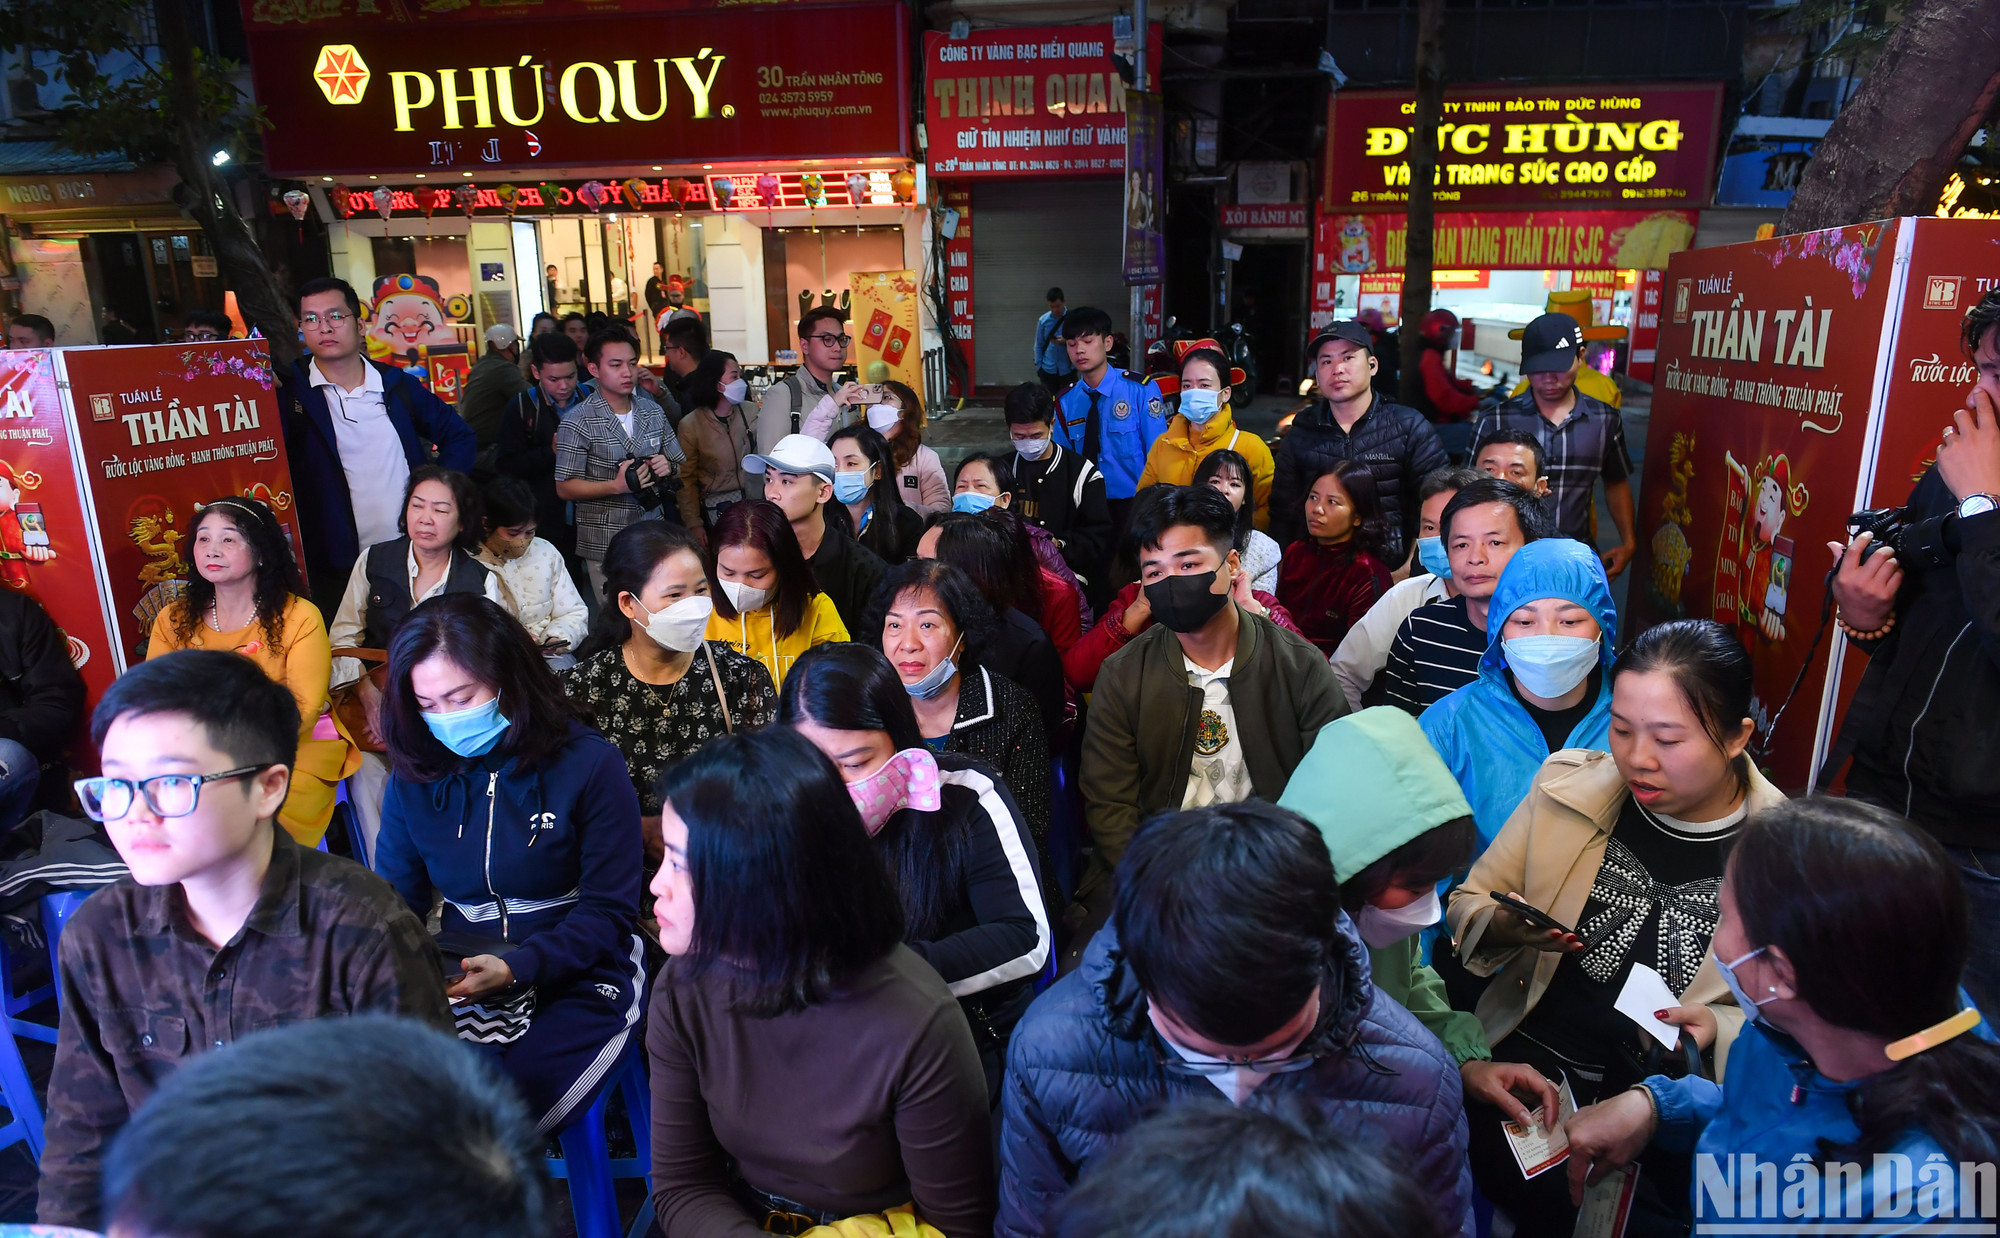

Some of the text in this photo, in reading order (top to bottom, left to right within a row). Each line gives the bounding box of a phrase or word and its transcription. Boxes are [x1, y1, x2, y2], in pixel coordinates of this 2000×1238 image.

[939, 44, 968, 62] CÔNG
[970, 46, 984, 61] TY
[986, 41, 1014, 60] VÀNG
[1017, 43, 1038, 63] BẠC
[1068, 42, 1104, 58] QUANG
[757, 66, 784, 88] 30
[819, 70, 851, 87] NHÂN
[852, 70, 883, 86] TÔNG
[388, 47, 726, 132] PHÚ QUÝ
[758, 91, 834, 104] 024 3573 5959
[933, 72, 1151, 124] THỊNH QUAN
[761, 104, 872, 119] www.phuquy.com.vn
[1443, 102, 1461, 113] TY
[1464, 101, 1501, 113] TNHH
[1504, 97, 1535, 112] BẢO
[1537, 97, 1560, 111] TÍN
[1565, 97, 1595, 111] ĐỨC
[1600, 96, 1641, 110] HÙNG
[957, 127, 978, 148] GIỮ
[981, 127, 1001, 147] TÍN
[1003, 128, 1041, 150] NHIỆM
[1044, 127, 1070, 145] NHƯ
[1072, 124, 1094, 145] GIỮ
[1097, 124, 1127, 145] VÀNG
[1503, 112, 1684, 154] HÙNG
[1447, 163, 1515, 186] TRANG
[1519, 157, 1561, 184] SỨC
[1564, 161, 1608, 184] CAO
[1615, 154, 1657, 183] CẤP
[1351, 191, 1369, 202] 26
[1225, 207, 1248, 224] XÔI
[1250, 206, 1287, 224] BÁNH
[1460, 218, 1500, 265] VÀNG
[1504, 212, 1544, 264] THẦN
[1547, 217, 1570, 264] TÀI
[1573, 224, 1605, 264] SJC
[951, 249, 967, 267] KÍNH
[950, 273, 969, 292] CHÀO
[1697, 271, 1733, 295] TUẦN LỄ
[953, 297, 967, 316] QUÝ
[1645, 288, 1659, 306] TÁC
[1690, 293, 1833, 368] THẦN TÀI
[1911, 354, 1975, 387] RƯỚC LỘC
[0, 384, 34, 418] ÀI
[150, 386, 163, 401] LỄ
[1681, 371, 1693, 396] LỘC
[1692, 370, 1709, 393] VÀNG
[1709, 366, 1730, 399] RỒNG
[1756, 378, 1782, 408] THÔNG
[1783, 382, 1816, 418] THUẬN
[1815, 384, 1843, 420] PHÁT
[122, 395, 260, 446] THẦN TÀI
[8, 426, 31, 441] THUẬN
[32, 425, 49, 439] PHÁT
[103, 456, 127, 479] RƯỚC
[129, 457, 143, 477] LỘC
[145, 455, 165, 472] VÀNG
[165, 448, 185, 468] RỒNG
[212, 444, 235, 461] THÔNG
[235, 440, 258, 458] THUẬN
[258, 436, 275, 453] PHÁT
[1719, 557, 1737, 579] MINH
[1715, 589, 1736, 611] CHÂU
[530, 822, 555, 830] PRIS
[596, 987, 618, 1000] PARIS
